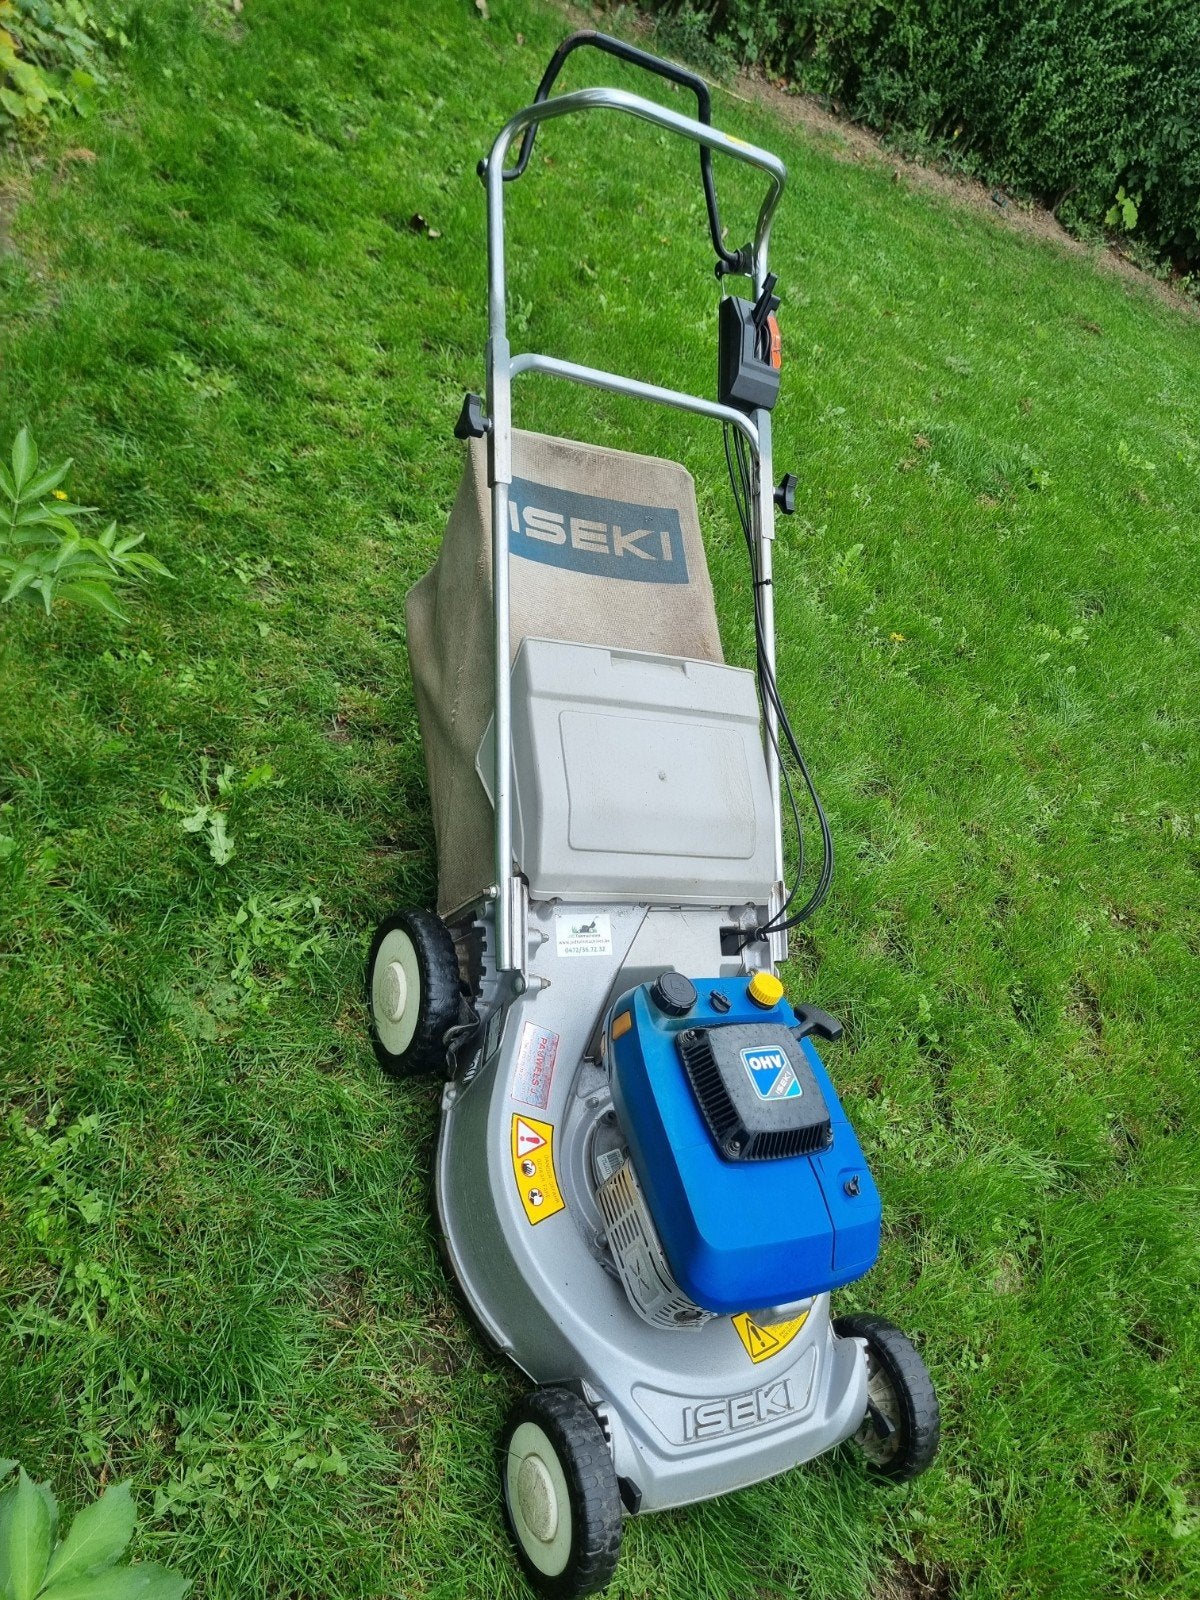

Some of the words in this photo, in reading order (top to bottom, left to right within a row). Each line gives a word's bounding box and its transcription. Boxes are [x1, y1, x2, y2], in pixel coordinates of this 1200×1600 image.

[508, 500, 673, 562] ISEKI
[531, 1036, 548, 1086] PAUWELS
[749, 1054, 782, 1071] OHV
[775, 1070, 792, 1096] ISEKI
[682, 1378, 795, 1442] ISEKI
